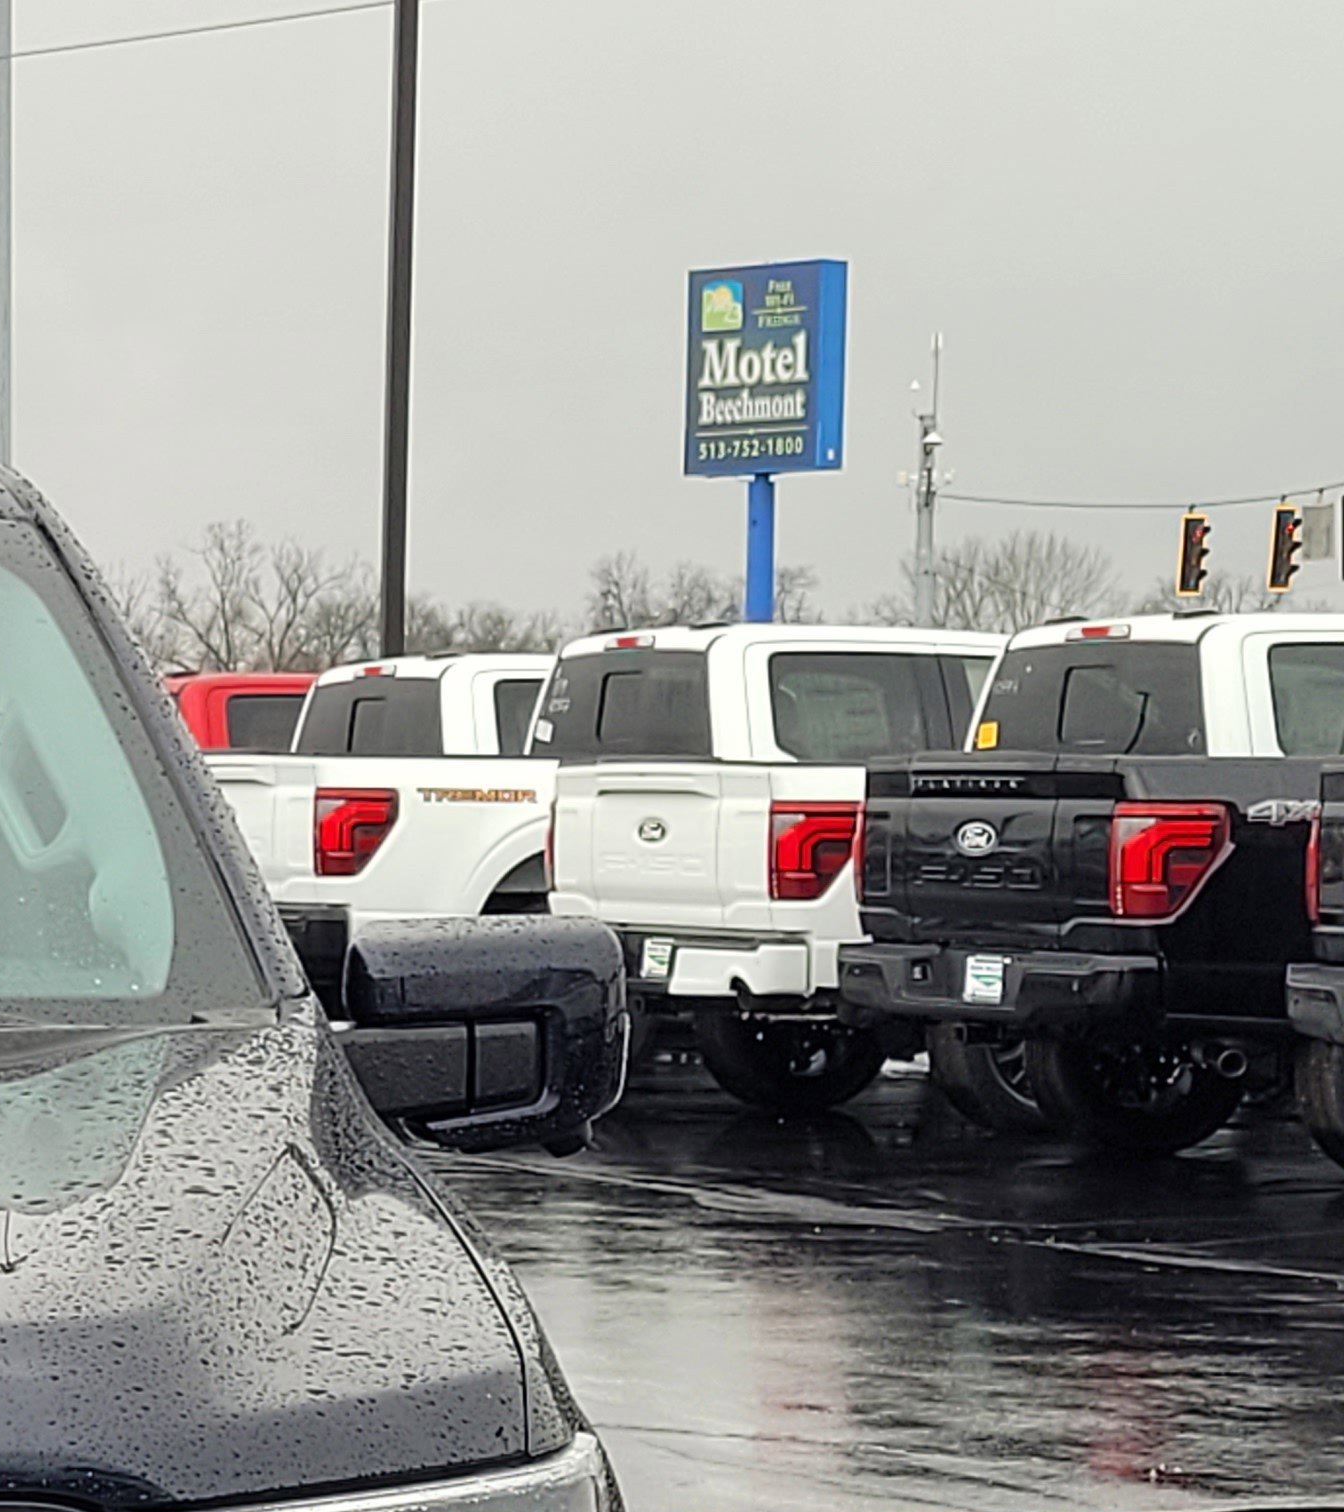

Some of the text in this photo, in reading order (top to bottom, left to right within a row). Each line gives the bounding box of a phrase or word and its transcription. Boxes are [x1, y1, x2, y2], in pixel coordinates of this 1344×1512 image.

[698, 329, 809, 388] Motel
[698, 388, 806, 426] Beechmont
[699, 436, 803, 460] 513-752-1800
[416, 787, 537, 804] TREMOR
